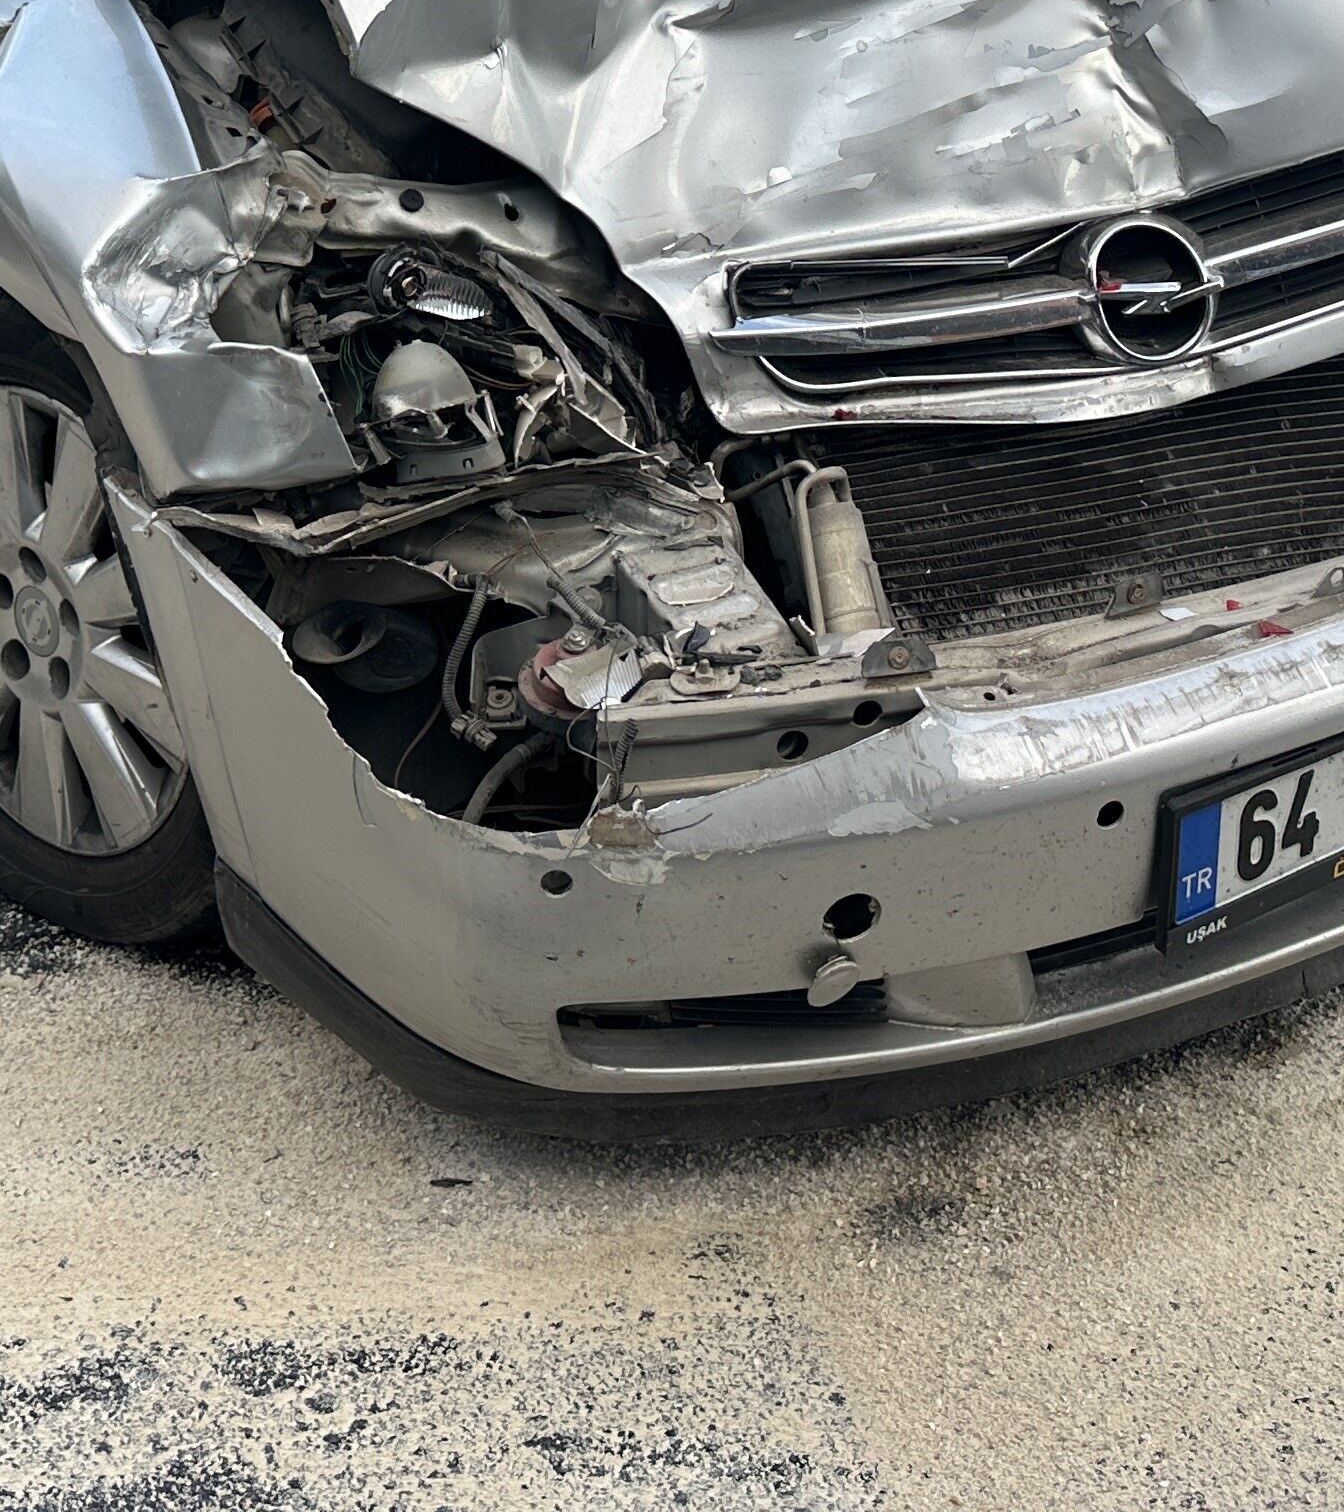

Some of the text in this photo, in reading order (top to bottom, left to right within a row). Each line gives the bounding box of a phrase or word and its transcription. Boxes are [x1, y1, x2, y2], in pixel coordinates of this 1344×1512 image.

[1236, 770, 1320, 881] 64
[1181, 866, 1213, 900] TR
[1186, 915, 1228, 945] UŞAK
